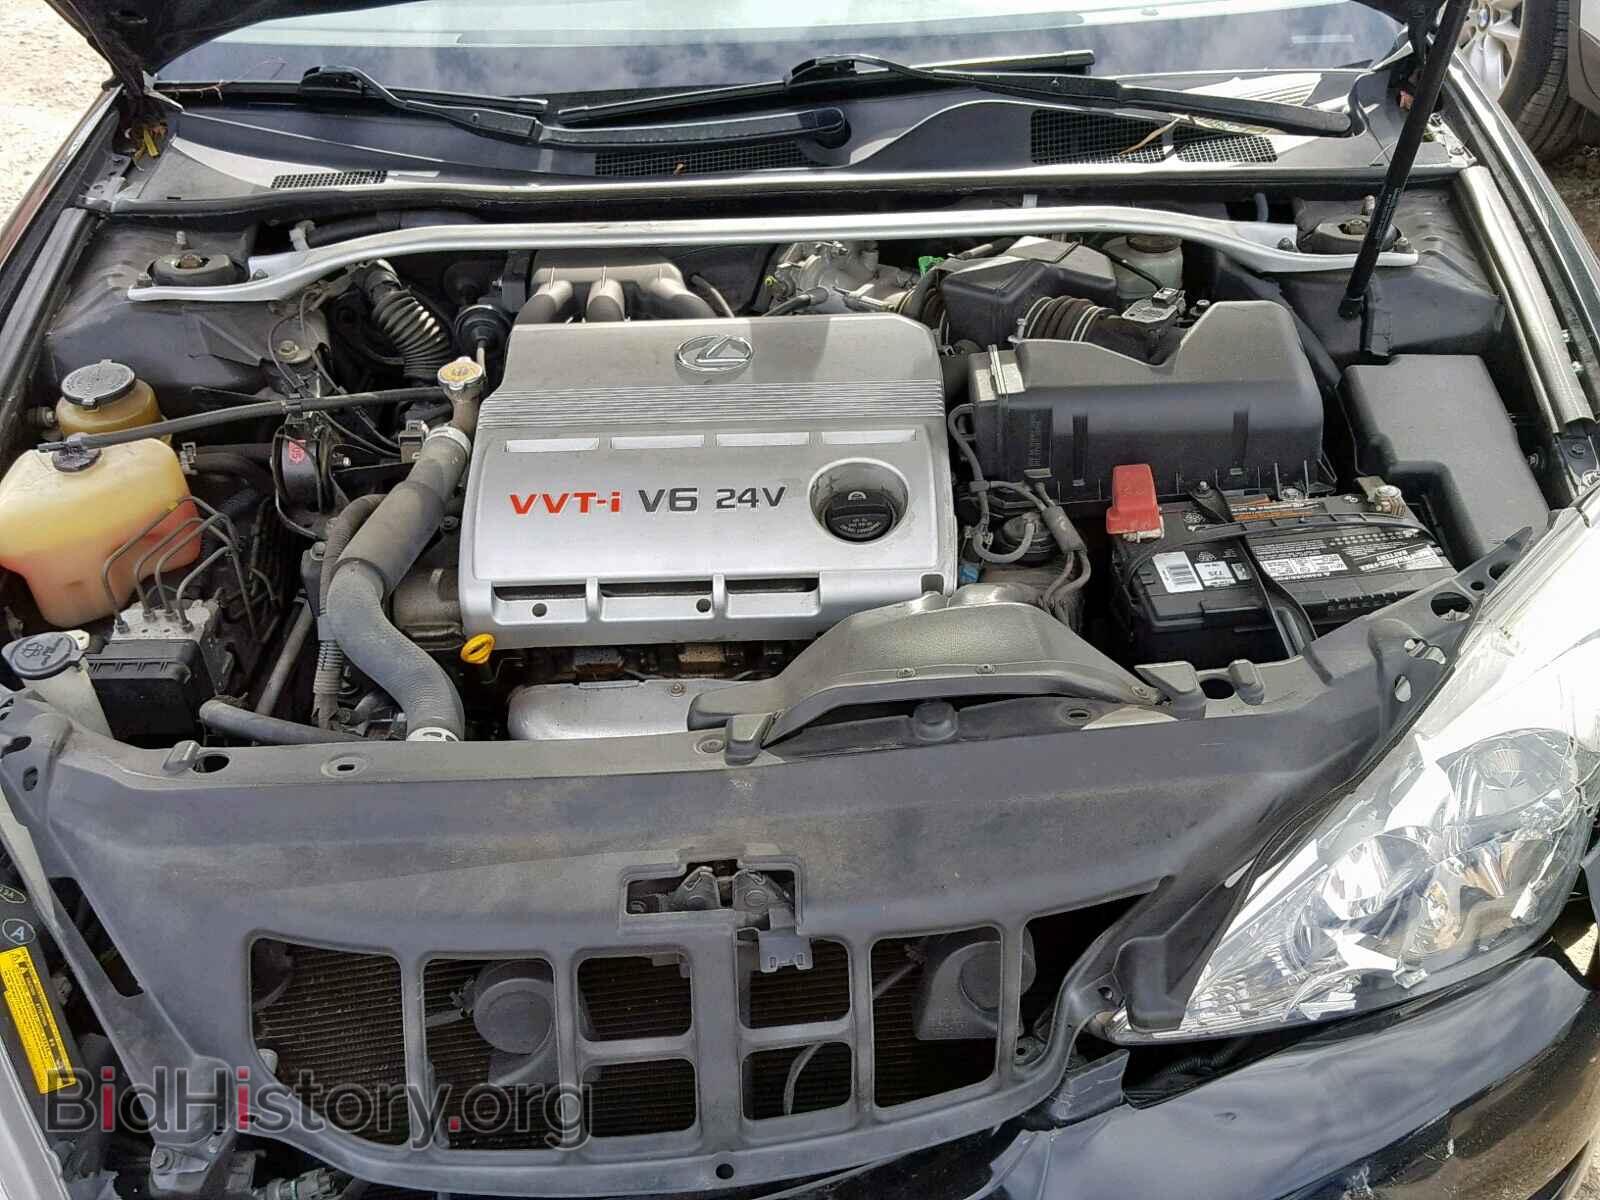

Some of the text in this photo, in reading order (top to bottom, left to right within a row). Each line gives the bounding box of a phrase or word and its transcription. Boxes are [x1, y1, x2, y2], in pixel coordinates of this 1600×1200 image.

[510, 486, 786, 514] VVT-i V6 24V
